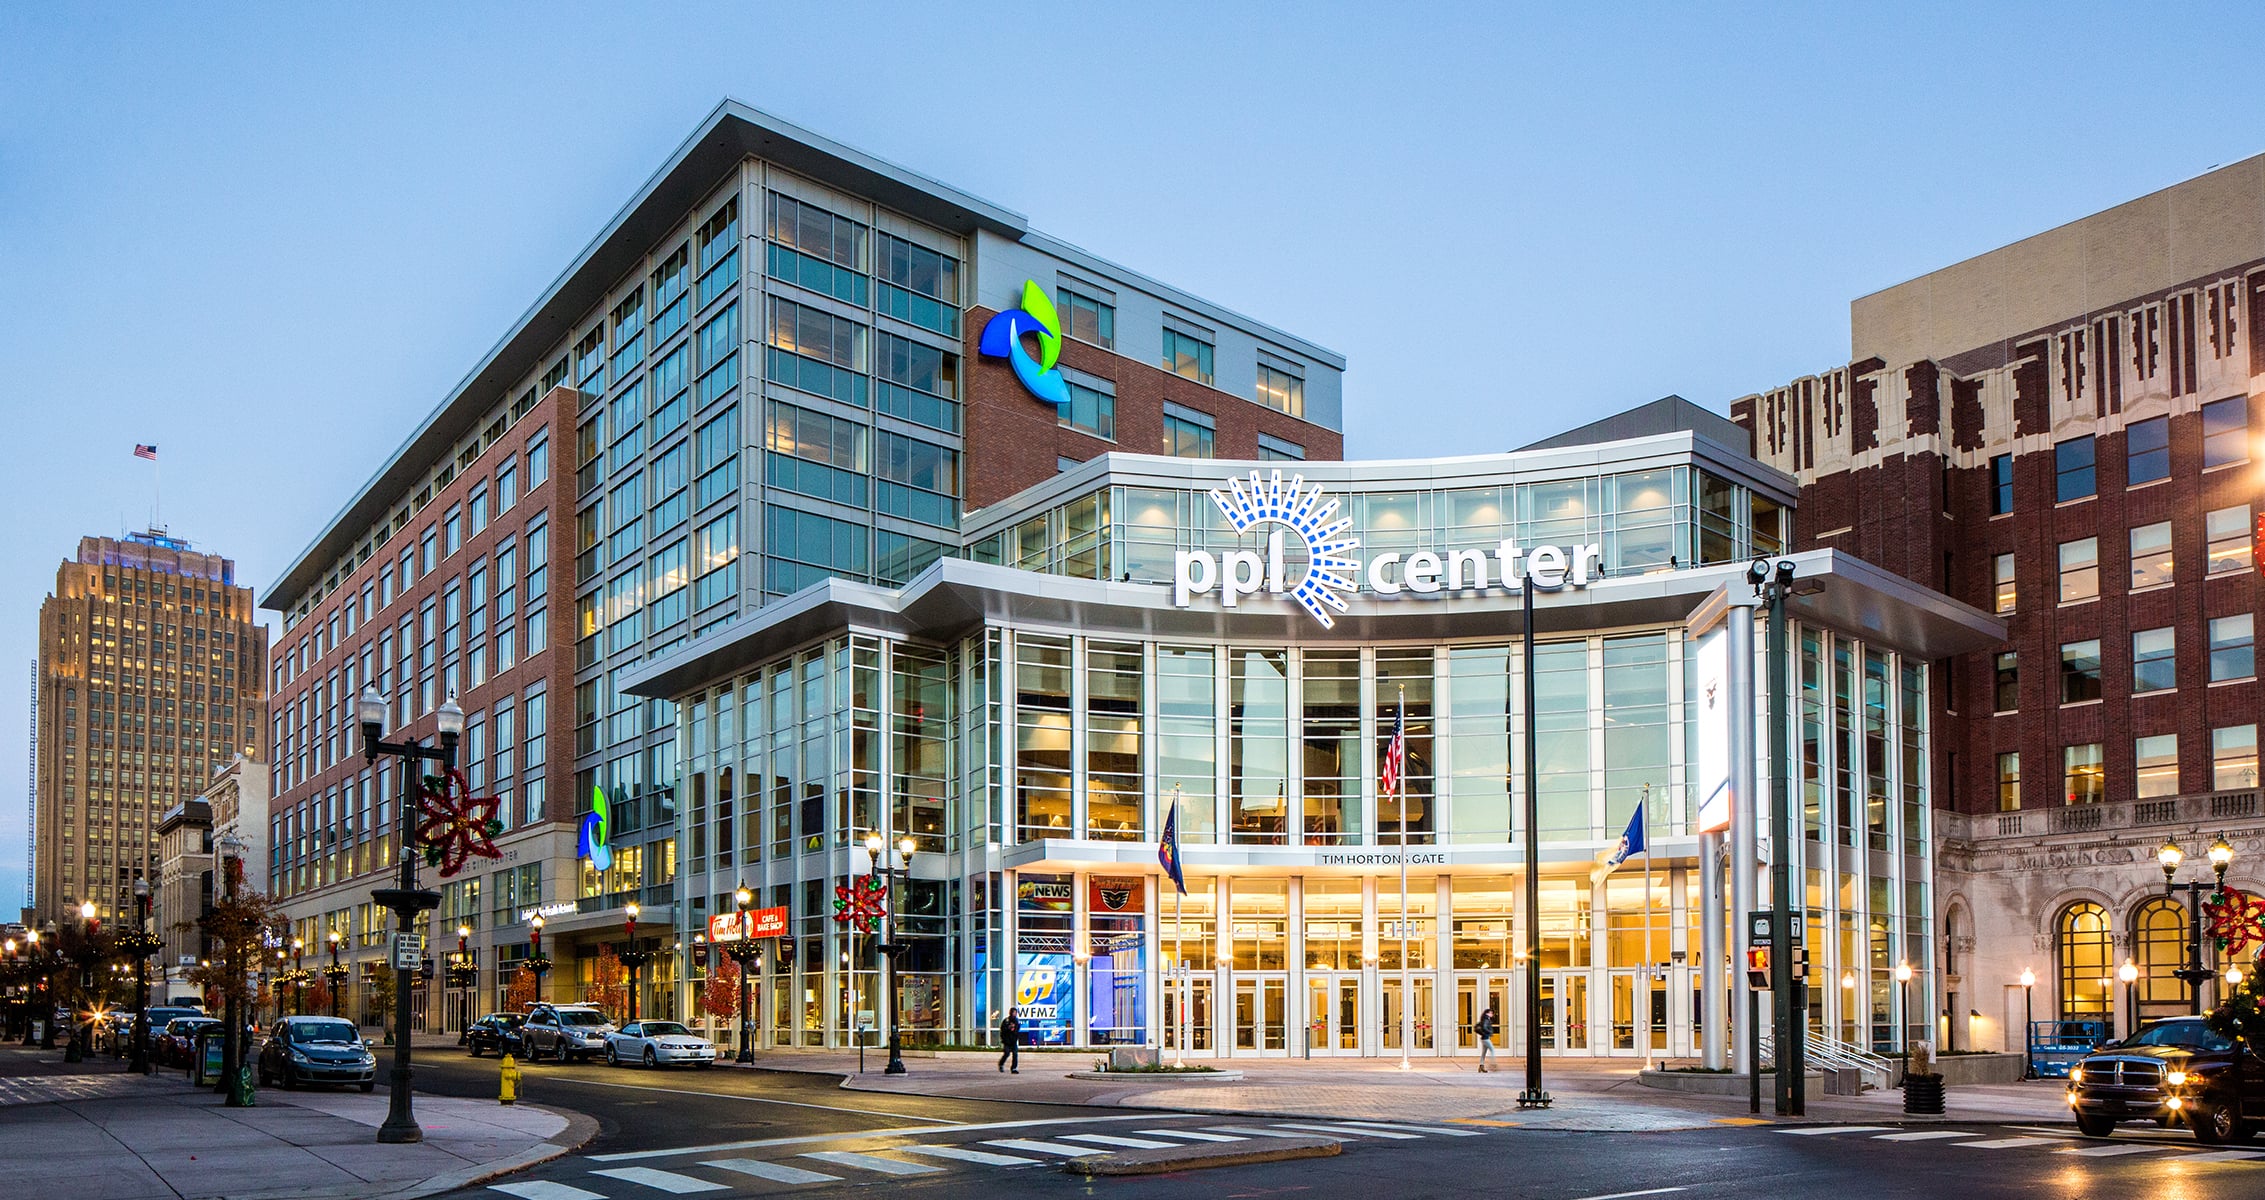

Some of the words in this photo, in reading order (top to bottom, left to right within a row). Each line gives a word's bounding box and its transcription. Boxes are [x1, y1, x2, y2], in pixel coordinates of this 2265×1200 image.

[1174, 528, 1284, 607] ppl
[1368, 538, 1599, 594] center
[1322, 855, 1343, 864] TIM
[1412, 854, 1445, 864] GATE
[1018, 881, 1034, 898] 69
[1035, 885, 1070, 897] NEWS
[713, 918, 725, 935] Tim
[757, 923, 770, 932] BAKE
[770, 921, 783, 930] SHOP
[1793, 922, 1798, 935] 7
[1017, 968, 1056, 1005] 69
[1017, 1007, 1056, 1017] WFMZ
